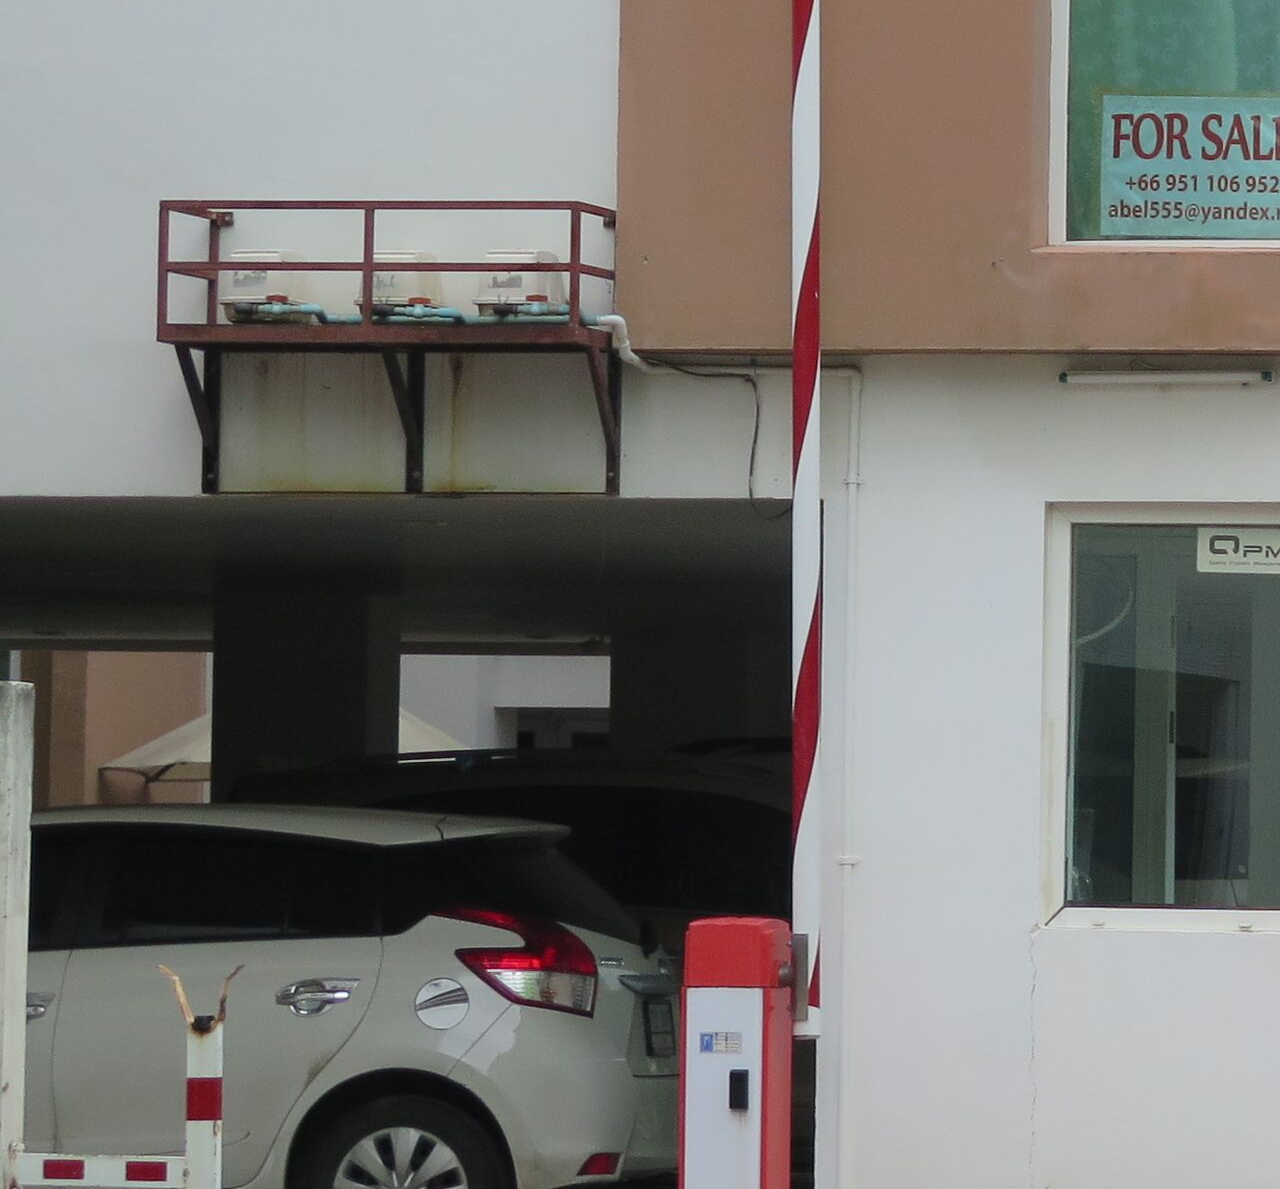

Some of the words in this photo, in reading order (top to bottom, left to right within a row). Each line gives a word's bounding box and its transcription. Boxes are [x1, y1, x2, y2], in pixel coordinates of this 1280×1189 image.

[1112, 113, 1191, 160] FOR
[1125, 174, 1160, 191] +66
[1166, 175, 1198, 192] 951
[1207, 175, 1240, 193] 106
[1245, 176, 1280, 193] 952
